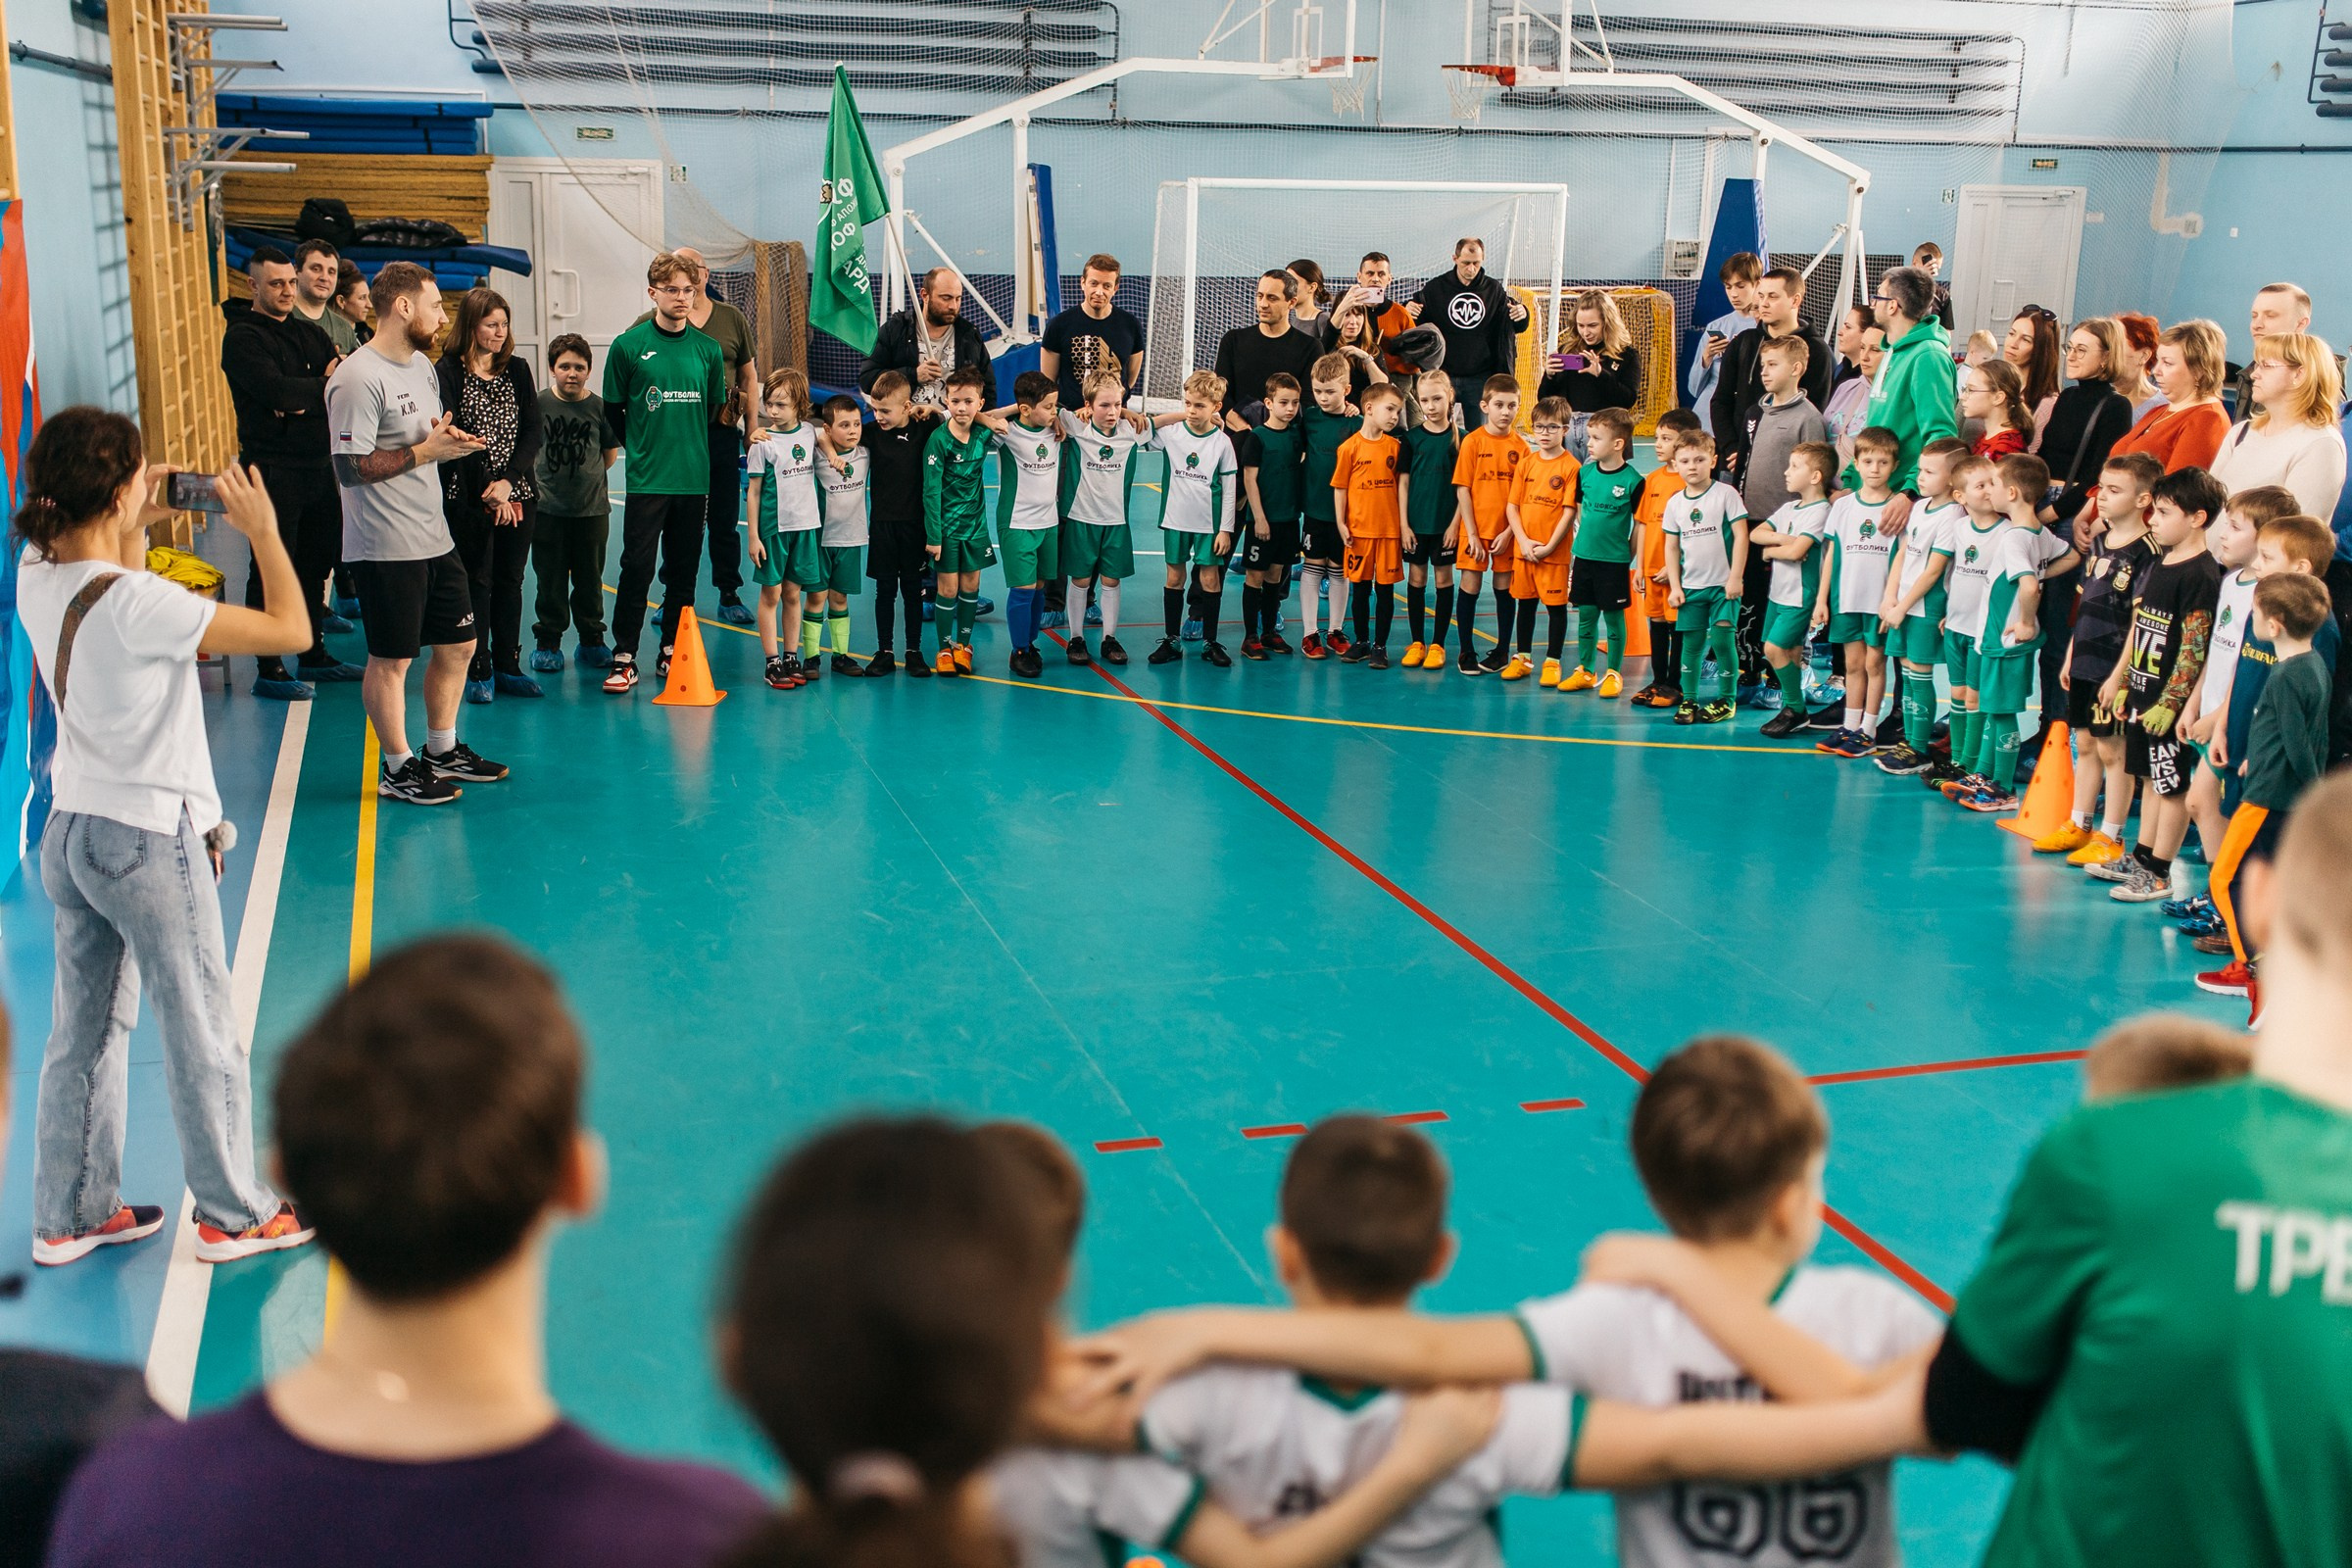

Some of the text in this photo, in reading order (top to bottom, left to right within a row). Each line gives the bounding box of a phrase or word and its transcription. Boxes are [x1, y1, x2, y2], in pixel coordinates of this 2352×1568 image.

[1086, 461, 1122, 469] ФУТБОЛИКА
[1174, 468, 1208, 481] ФУТБОЛИКА
[1250, 546, 1260, 563] 5
[1348, 554, 1364, 571] 67
[2143, 605, 2174, 620] ALWAYS
[2139, 616, 2170, 632] AWESOME
[2131, 627, 2167, 675] VE
